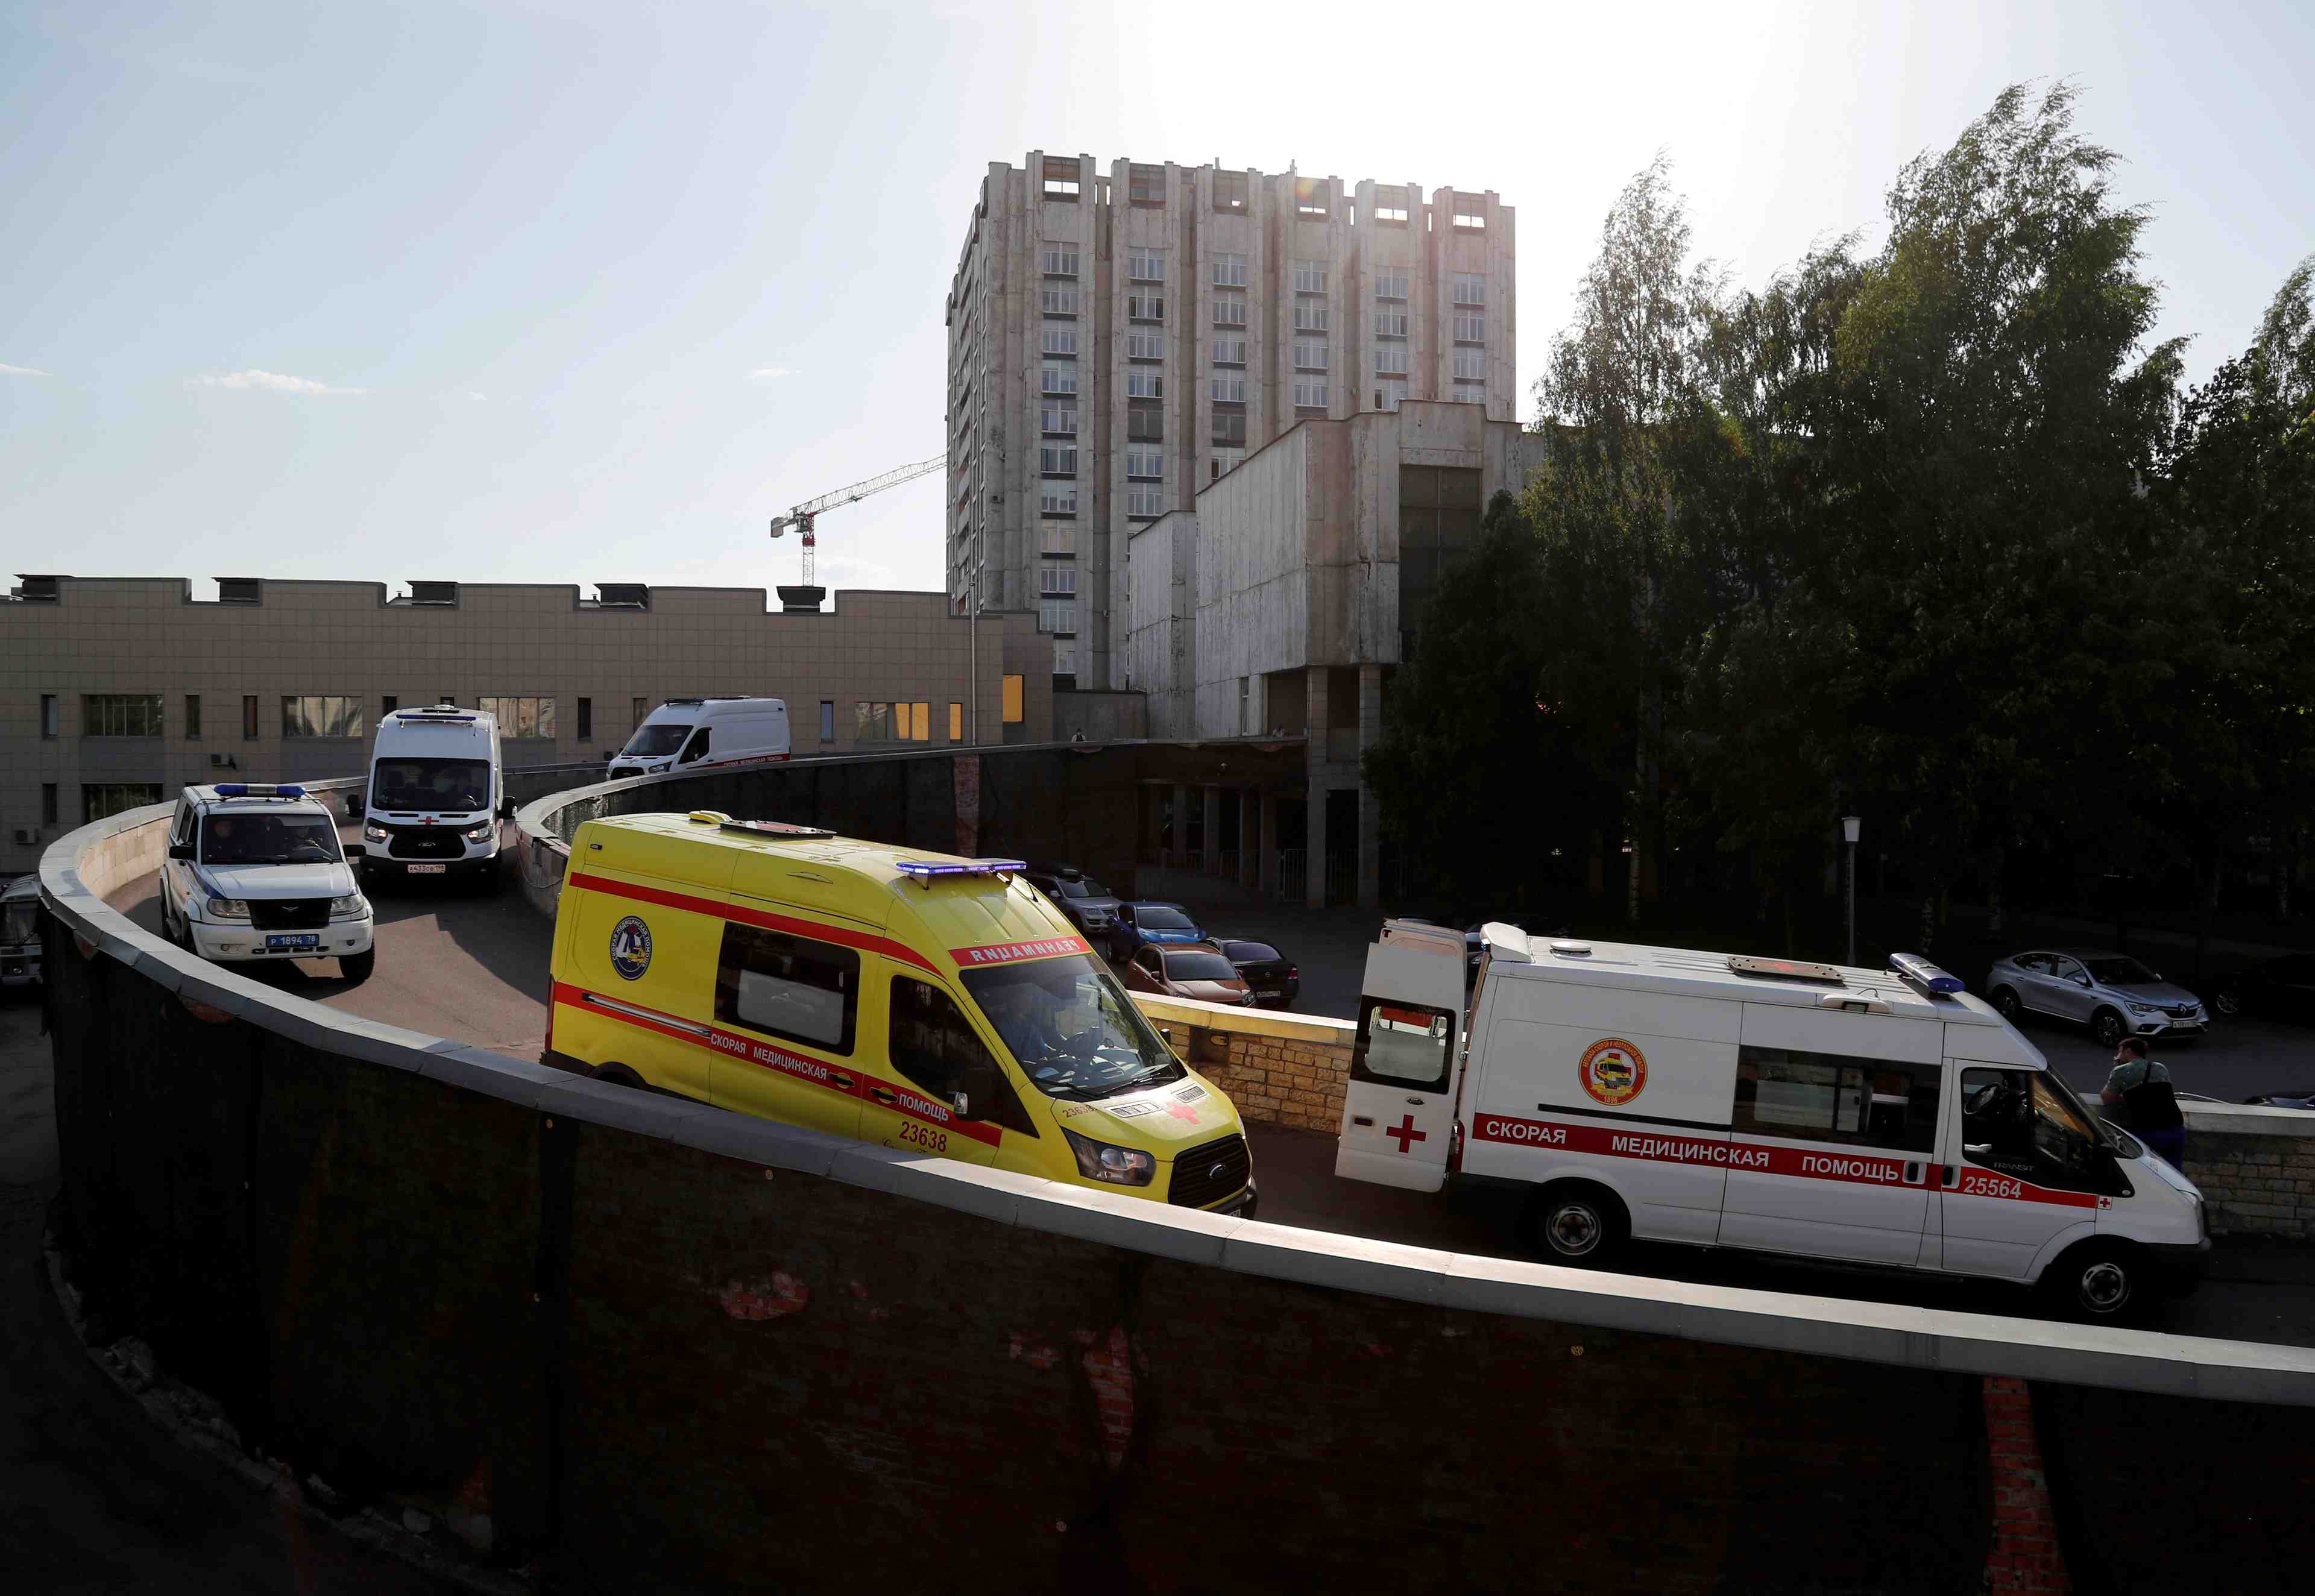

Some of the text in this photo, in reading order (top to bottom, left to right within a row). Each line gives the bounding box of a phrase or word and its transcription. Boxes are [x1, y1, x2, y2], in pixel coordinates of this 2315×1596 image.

[280, 935, 302, 945] 1894
[711, 1033, 949, 1122] СКОРАЯ МЕДИЦИНСКАЯ ПОМОЩЬ
[899, 1121, 947, 1152] 23638
[1485, 1121, 1899, 1182] СКОРАЯ МЕДИЦИНСКАЯ ПОМОЩЬ
[1992, 1161, 2035, 1172] TRANSIT
[1963, 1176, 2021, 1199] 25564
